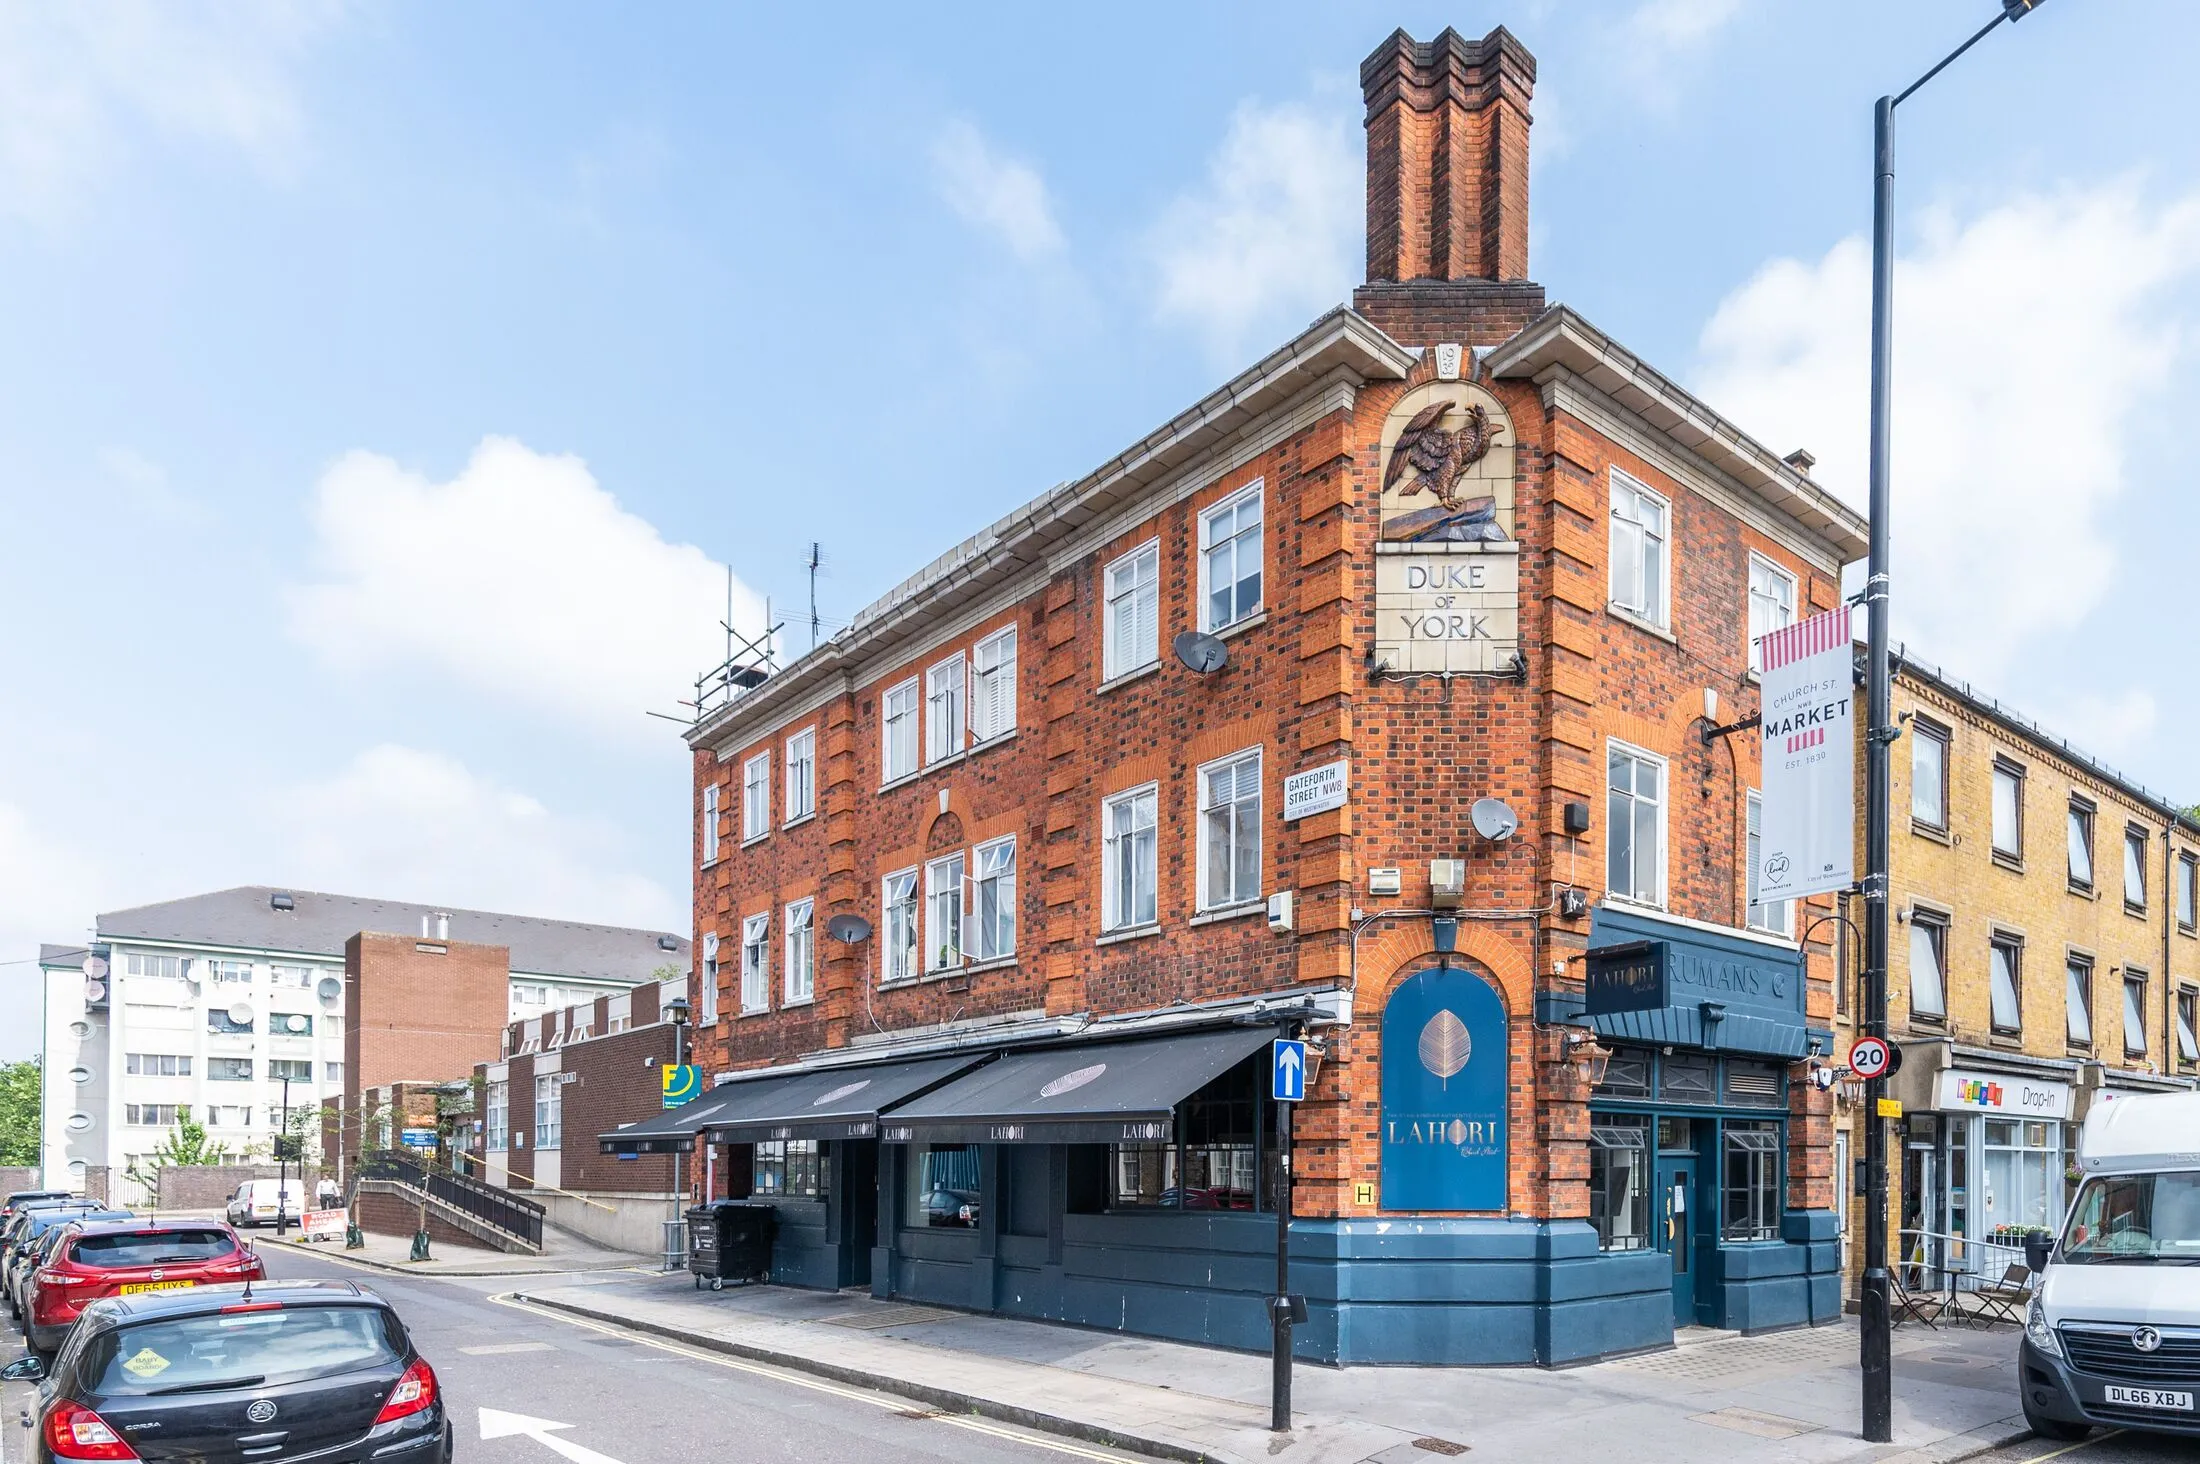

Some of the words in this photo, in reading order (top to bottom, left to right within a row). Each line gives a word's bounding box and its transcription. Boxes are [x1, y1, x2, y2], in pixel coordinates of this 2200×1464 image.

[1408, 565, 1485, 589] DUKE
[1434, 596, 1456, 609] OF
[1400, 615, 1491, 639] YORK
[1773, 683, 1818, 709] CHURCH
[1822, 680, 1838, 690] ST.
[1797, 701, 1812, 710] NW8
[1765, 699, 1849, 740] MARKET
[1785, 760, 1802, 770] EST.
[1806, 751, 1826, 764] 1830
[1288, 768, 1336, 792] GATEFORTH
[1288, 786, 1319, 806] STREET
[1322, 780, 1342, 796] NW8
[1855, 1049, 1883, 1066] 20
[2022, 1086, 2055, 1111] Drop-In
[991, 1125, 1024, 1140] LAHORI
[1122, 1122, 1165, 1139] LAHORI
[1387, 1119, 1497, 1145] LAHORI
[1357, 1185, 1371, 1202] H
[311, 1211, 337, 1219] ROAD
[2111, 1388, 2150, 1403] DL66
[2154, 1391, 2186, 1407] XBJ
[125, 1421, 161, 1431] CORSA
